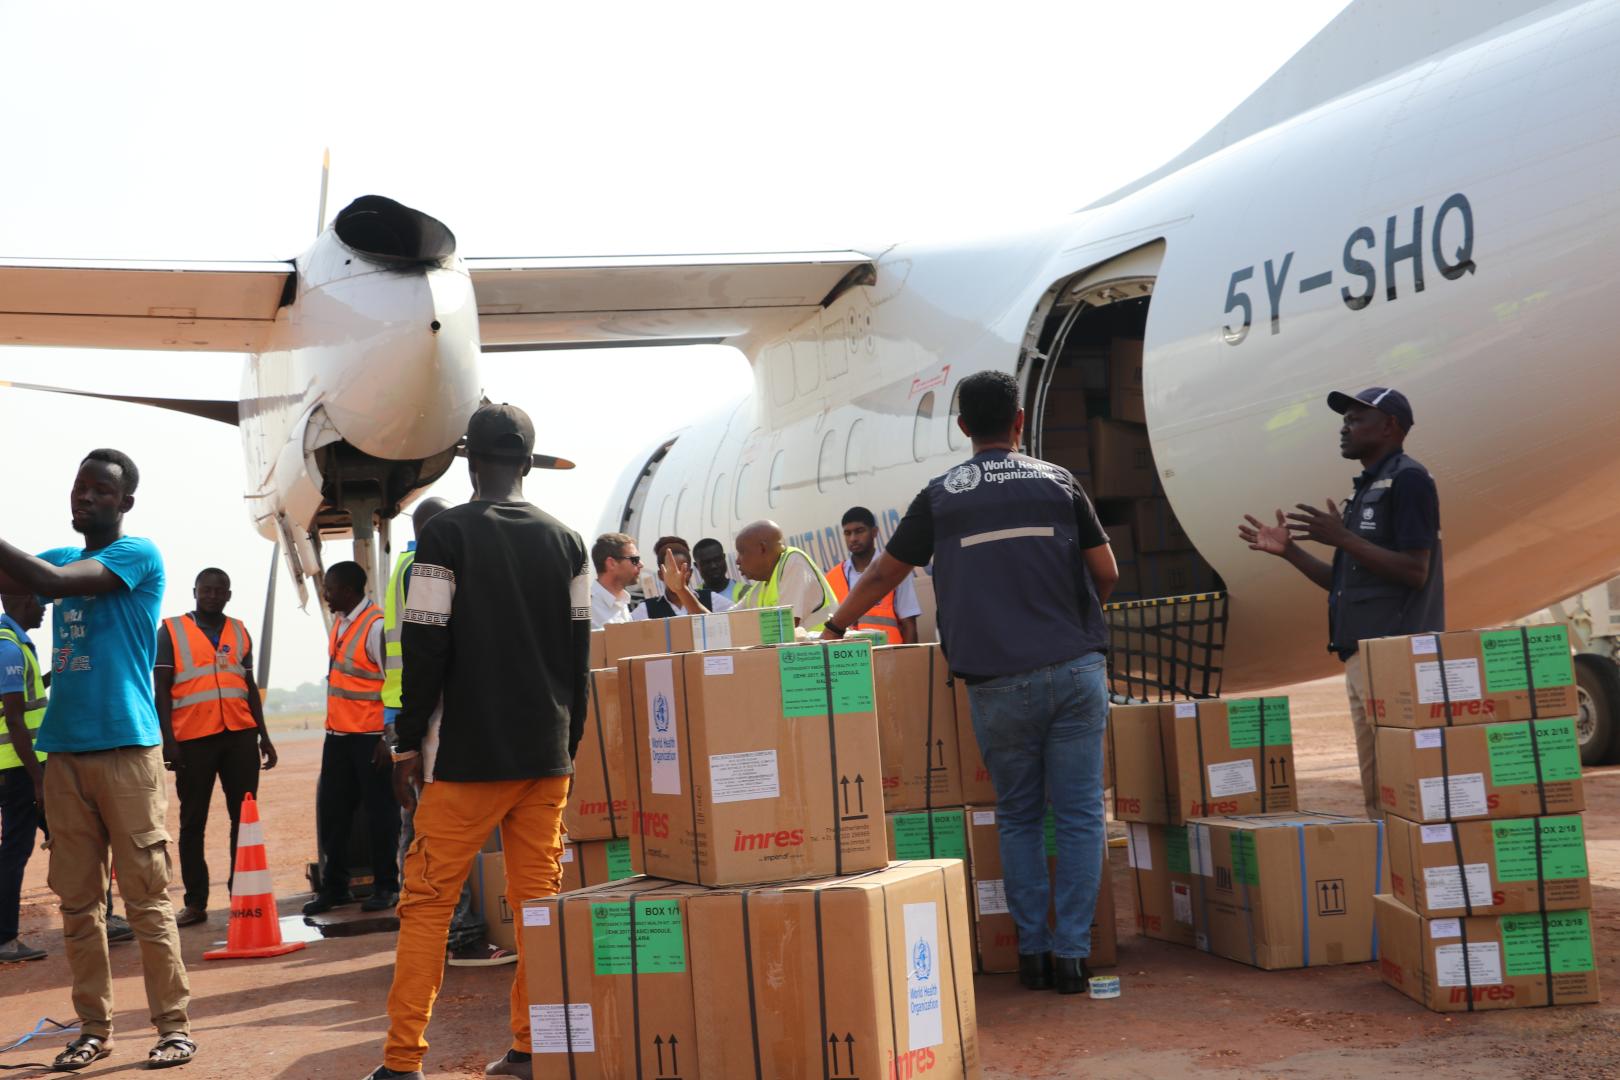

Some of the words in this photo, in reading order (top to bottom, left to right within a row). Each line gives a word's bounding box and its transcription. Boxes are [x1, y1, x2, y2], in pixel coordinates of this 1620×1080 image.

[1222, 193, 1476, 346] 5Y-SHQ
[982, 459, 1015, 471] World
[1018, 460, 1053, 471] Health
[984, 469, 1056, 483] Organization
[833, 650, 854, 659] BOX
[856, 649, 868, 658] 1/1
[734, 829, 804, 852] imres
[645, 907, 665, 916] BOX
[668, 907, 681, 916] 1/1
[910, 986, 923, 1000] World
[924, 985, 938, 997] Health
[911, 998, 939, 1016] Organization
